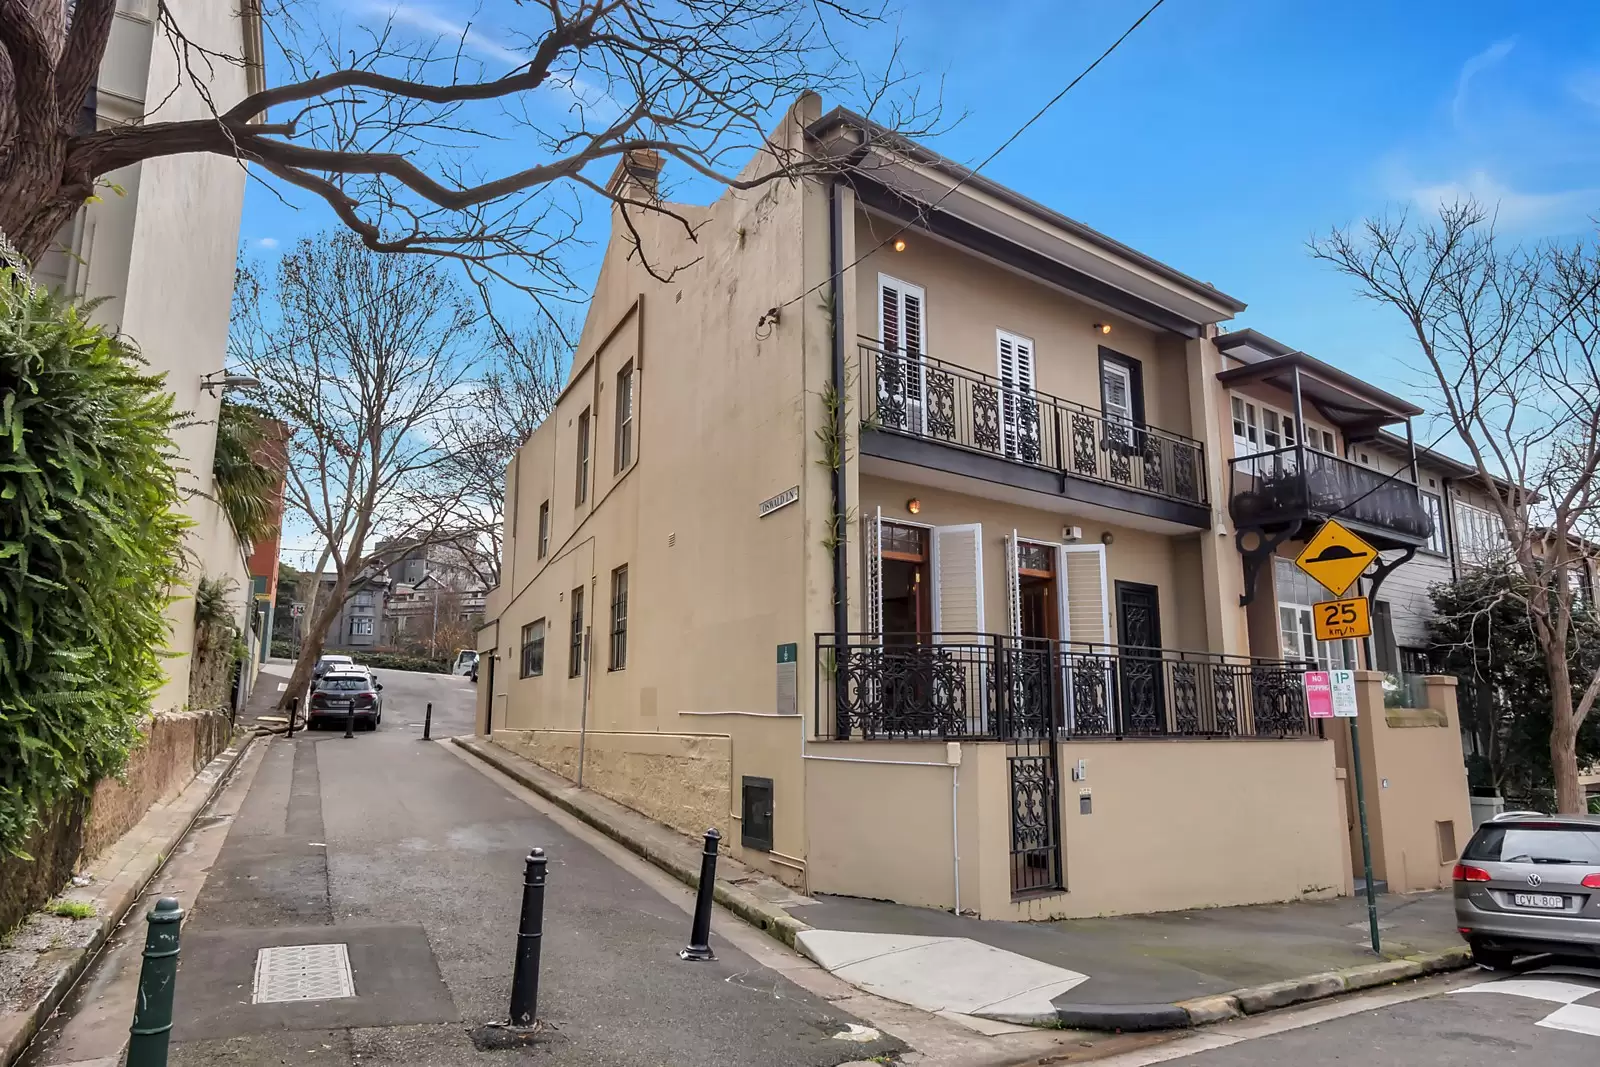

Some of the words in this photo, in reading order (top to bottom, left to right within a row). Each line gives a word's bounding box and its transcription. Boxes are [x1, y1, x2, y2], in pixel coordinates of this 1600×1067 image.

[762, 495, 785, 513] OSWALD
[786, 490, 794, 502] LN
[1325, 603, 1357, 626] 25
[1329, 627, 1355, 637] km/h
[1335, 672, 1350, 684] 1P
